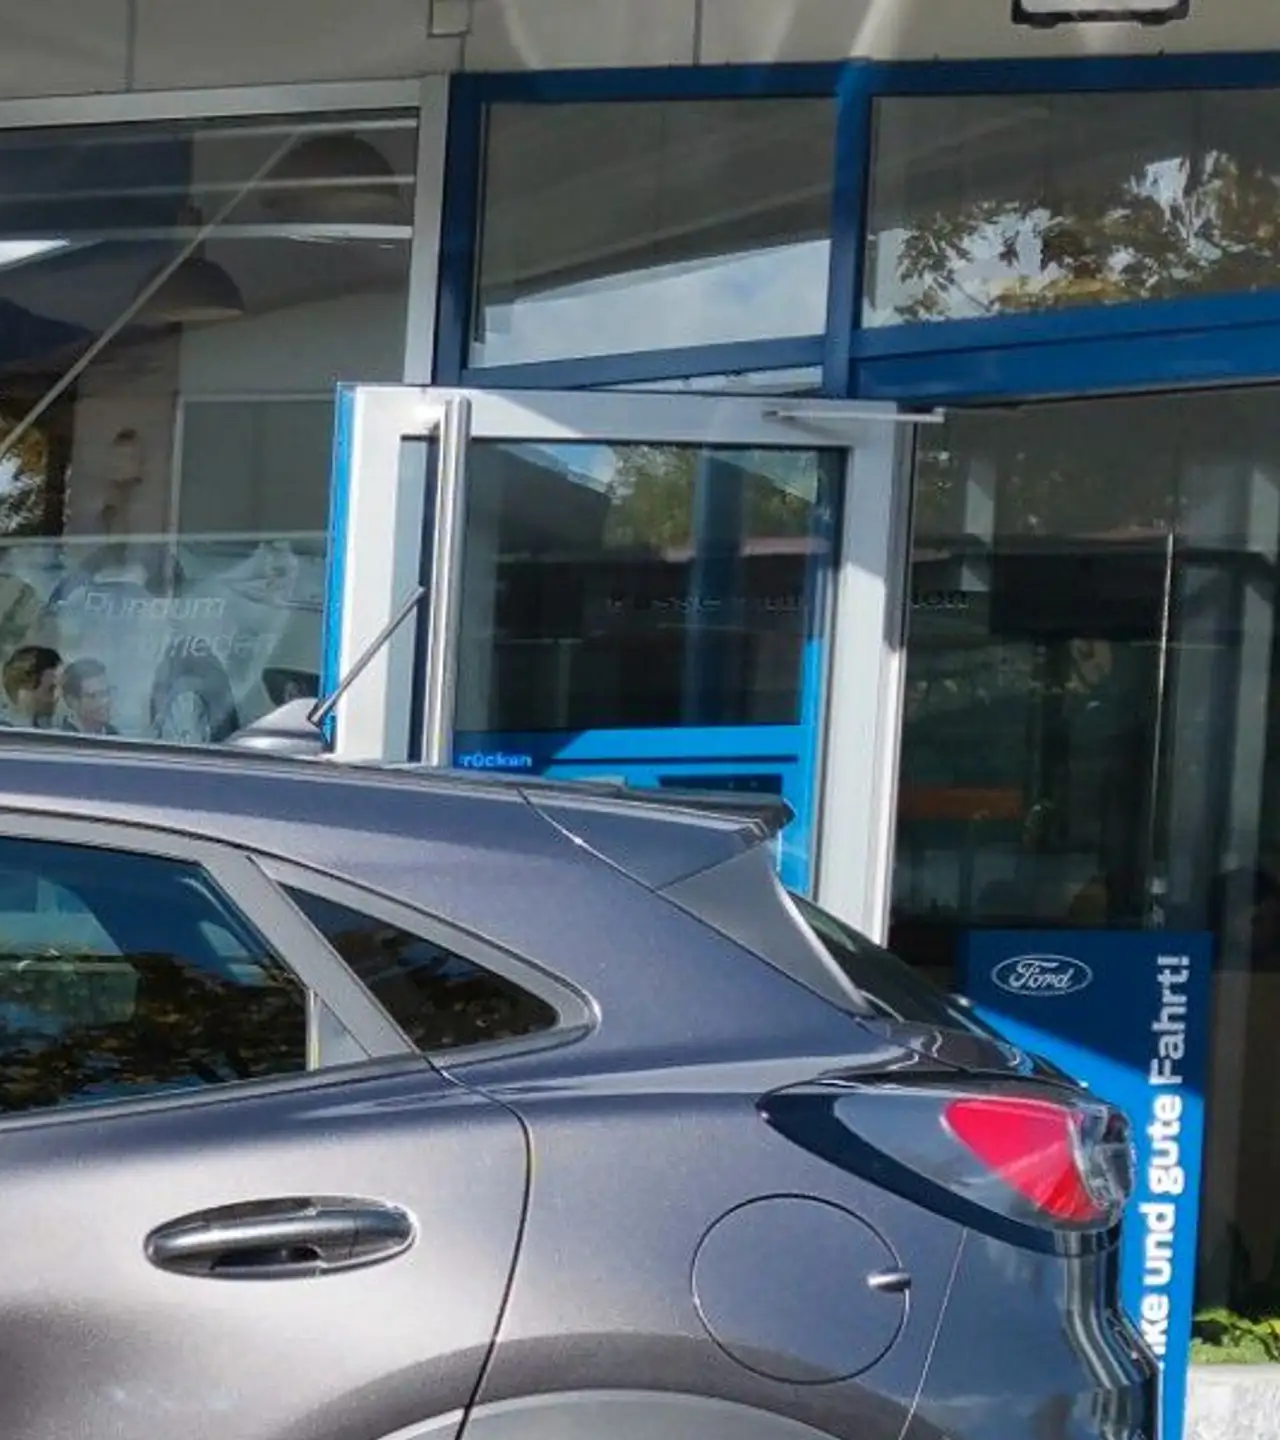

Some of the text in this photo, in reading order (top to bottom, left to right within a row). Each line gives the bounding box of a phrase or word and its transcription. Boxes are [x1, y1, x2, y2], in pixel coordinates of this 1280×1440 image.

[1009, 959, 1076, 989] Ford
[1147, 954, 1191, 1086] Fahrt!
[1146, 1093, 1186, 1196] gute
[1138, 1201, 1176, 1286] und
